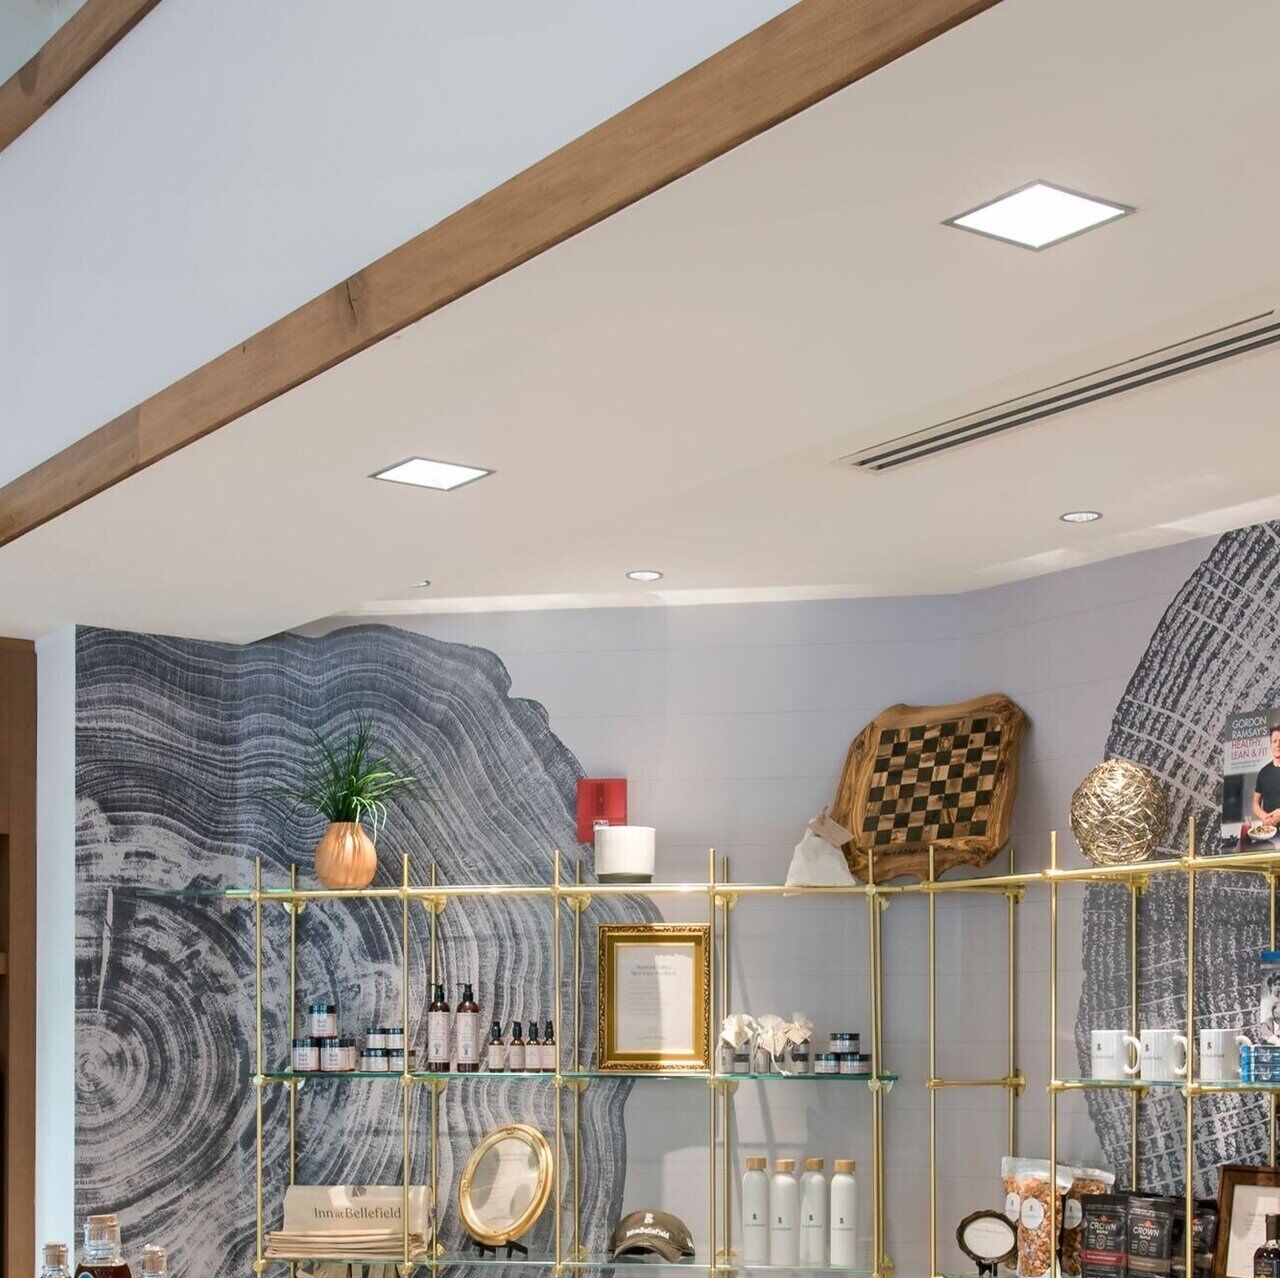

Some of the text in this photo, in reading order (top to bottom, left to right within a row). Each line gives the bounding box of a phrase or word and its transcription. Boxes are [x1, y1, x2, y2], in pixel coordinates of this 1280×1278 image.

[1232, 716, 1267, 729] GORDON
[1232, 726, 1268, 739] RAMSAY'S
[1231, 750, 1250, 760] LEAN
[1259, 747, 1268, 757] FIT
[315, 1207, 333, 1218] Inn
[345, 1207, 401, 1219] Bellefield
[1089, 1221, 1117, 1231] CROWN
[1133, 1226, 1160, 1236] CROWN
